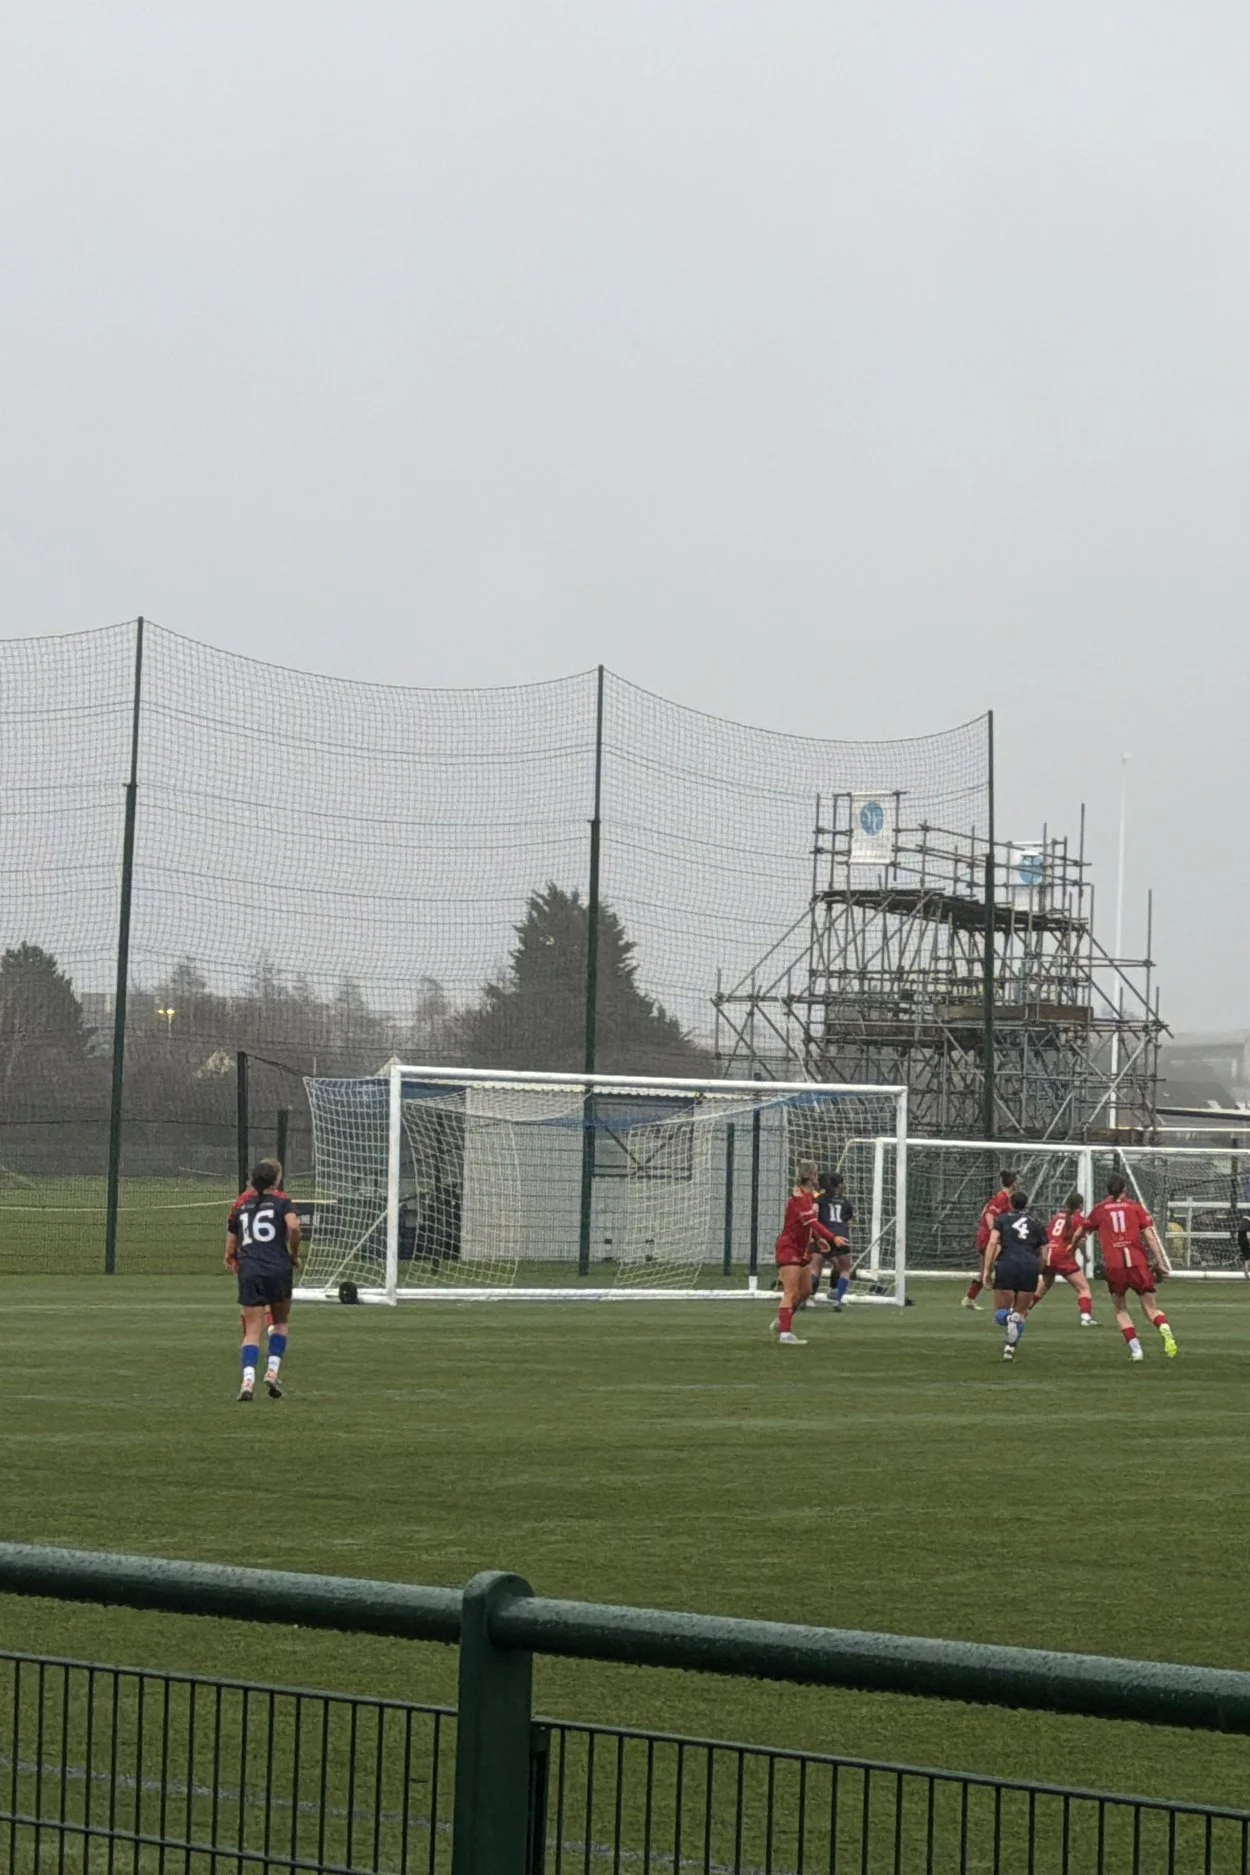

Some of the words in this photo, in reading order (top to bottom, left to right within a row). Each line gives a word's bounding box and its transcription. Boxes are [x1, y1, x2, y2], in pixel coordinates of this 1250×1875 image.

[828, 1203, 842, 1223] 11
[1110, 1210, 1126, 1233] 11
[240, 1209, 276, 1246] 16
[1011, 1217, 1029, 1239] 4
[1052, 1219, 1065, 1236] 8
